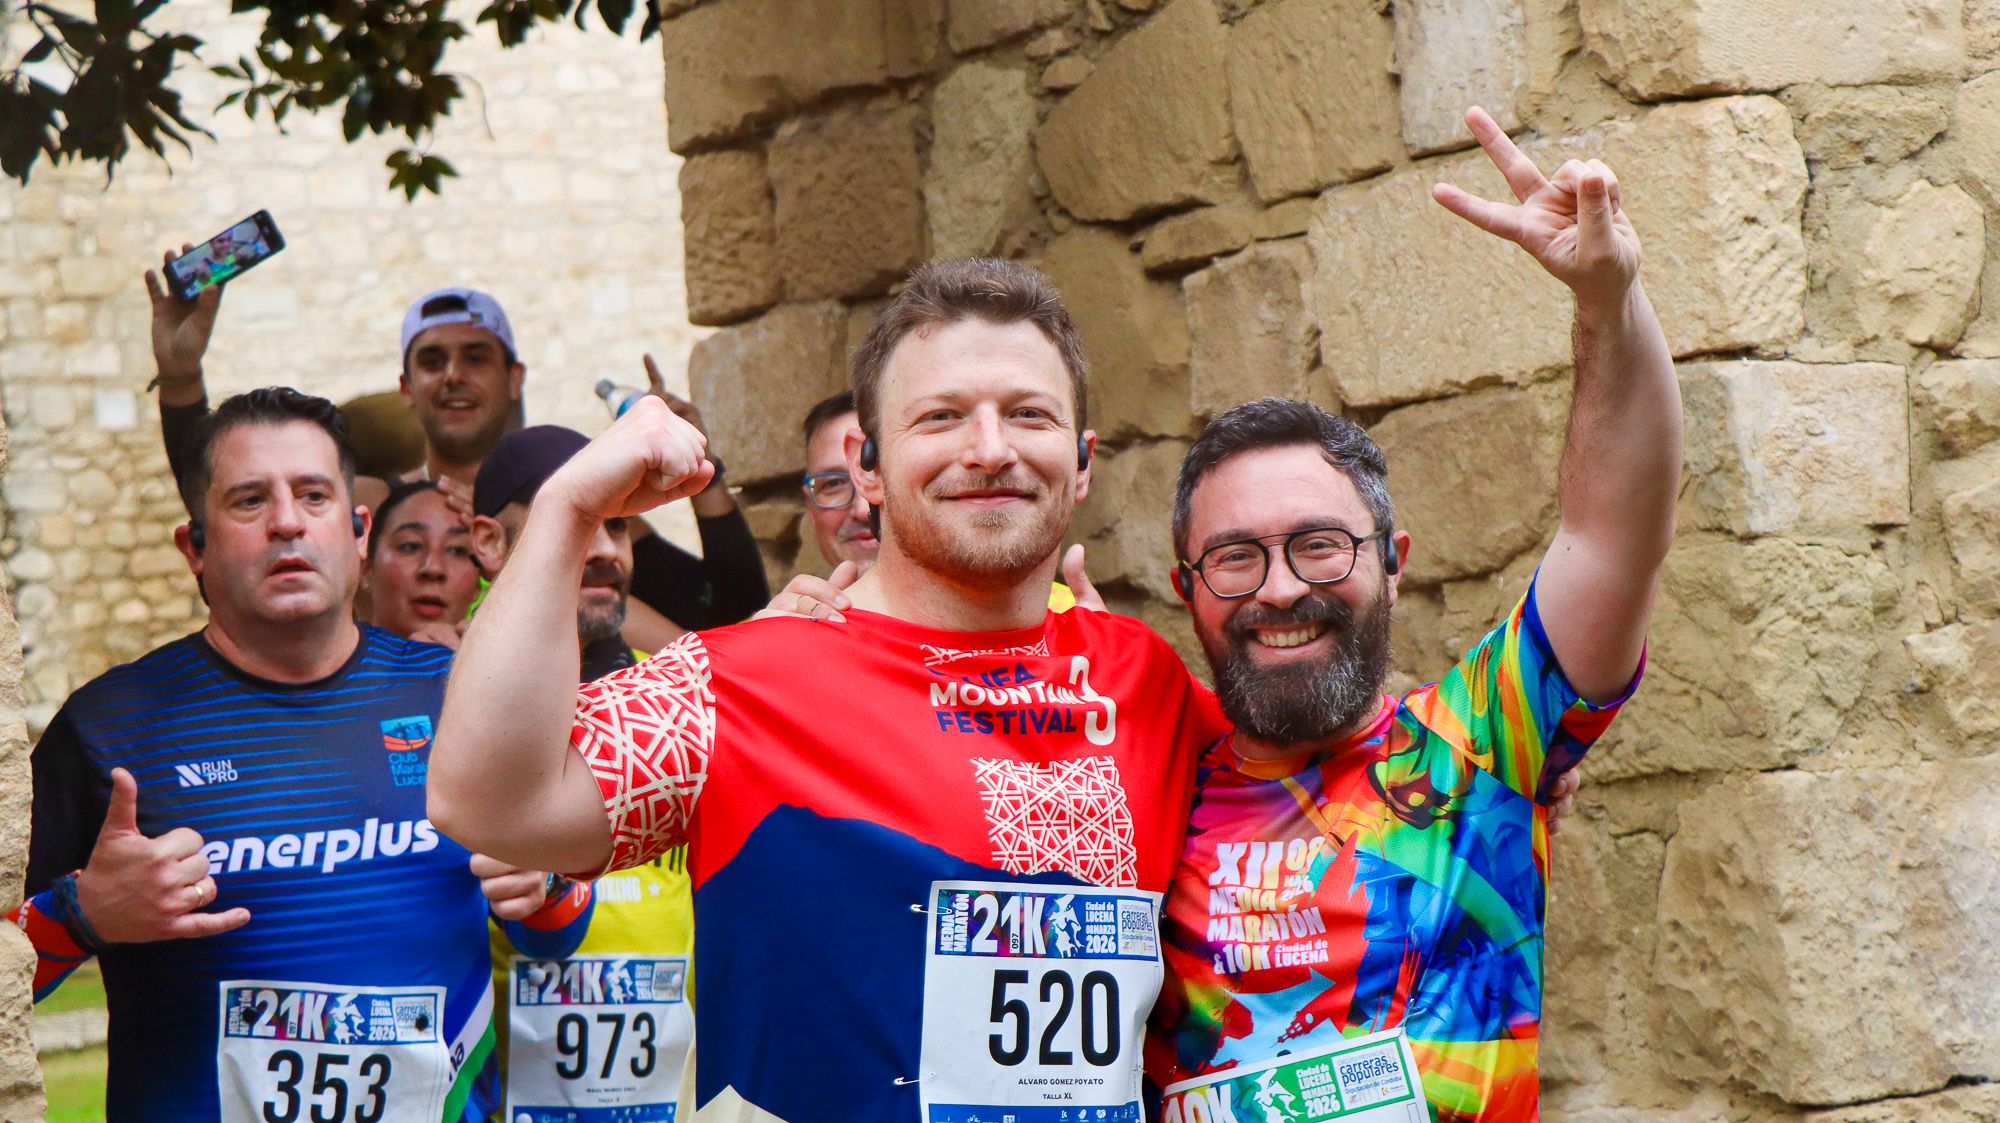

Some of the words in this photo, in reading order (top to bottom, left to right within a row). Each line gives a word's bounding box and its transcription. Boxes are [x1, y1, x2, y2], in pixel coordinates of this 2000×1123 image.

[936, 708, 1077, 735] FESTIVAL
[201, 760, 232, 774] RUN
[208, 769, 239, 784] PRO
[200, 818, 440, 874] enerplus
[1208, 841, 1284, 889] XII
[1209, 886, 1277, 916] MEDIA
[953, 894, 969, 951] MARATÓN
[971, 893, 1047, 955] 21K
[1085, 911, 1115, 923] LUCENA
[1121, 911, 1149, 922] carreras
[1207, 904, 1327, 942] MARATÓN
[941, 914, 954, 951] MEDIA
[1011, 933, 1019, 949] 097
[1085, 935, 1116, 953] 2026
[1275, 940, 1313, 953] Ciudad
[1314, 939, 1328, 949] de
[1223, 943, 1272, 973] 10K
[1275, 949, 1330, 968] LUCENA
[542, 961, 605, 1003] 21K
[253, 989, 328, 1041] 21K
[989, 969, 1121, 1066] 520
[368, 1026, 396, 1041] 2026
[556, 1012, 657, 1080] 973
[1340, 1056, 1388, 1076] carreras
[1342, 1061, 1400, 1087] populares
[263, 1050, 393, 1123] 353
[1063, 1092, 1073, 1100] XL
[1165, 1082, 1238, 1123] 10K
[1305, 1093, 1341, 1119] 2026
